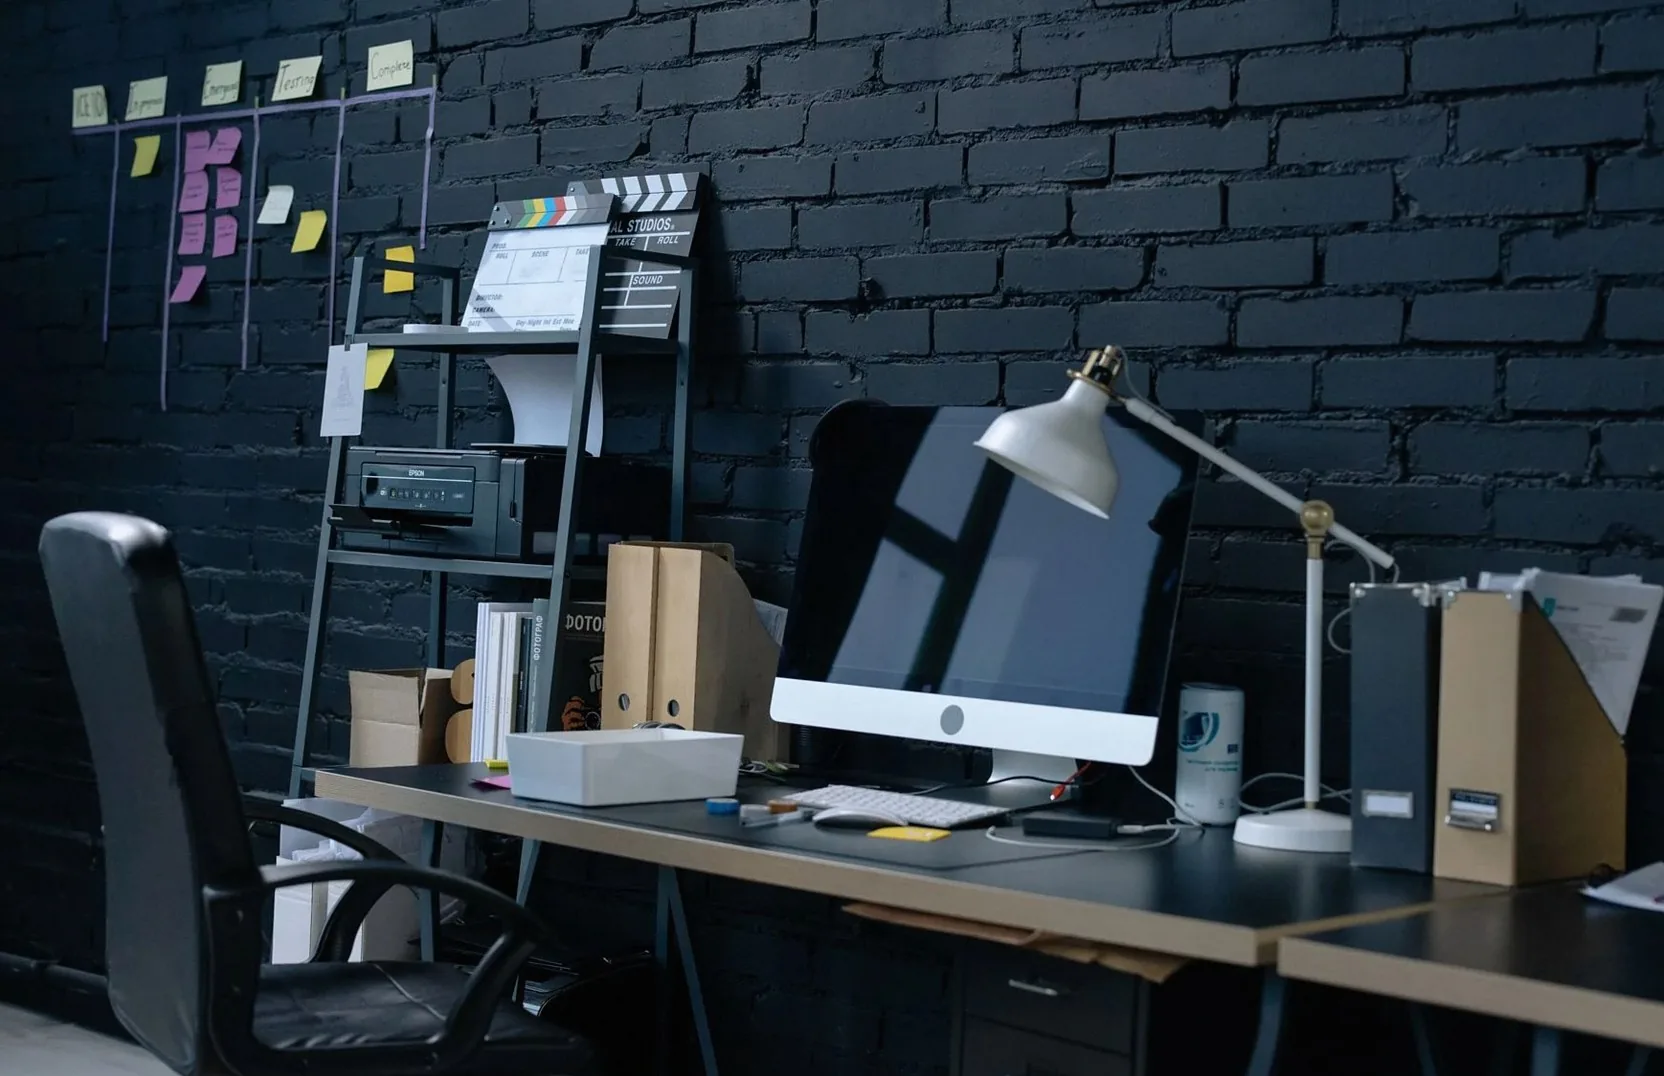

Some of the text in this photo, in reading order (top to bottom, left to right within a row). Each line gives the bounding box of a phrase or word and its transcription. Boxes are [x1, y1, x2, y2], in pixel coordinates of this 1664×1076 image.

[371, 52, 411, 80] Complete
[279, 64, 315, 94] Testing
[609, 220, 623, 233] AL
[616, 238, 636, 246] TAKE
[657, 236, 679, 244] ROLL
[633, 275, 663, 285] SOUND
[408, 469, 425, 477] EPSON
[565, 614, 605, 632] ФОТО
